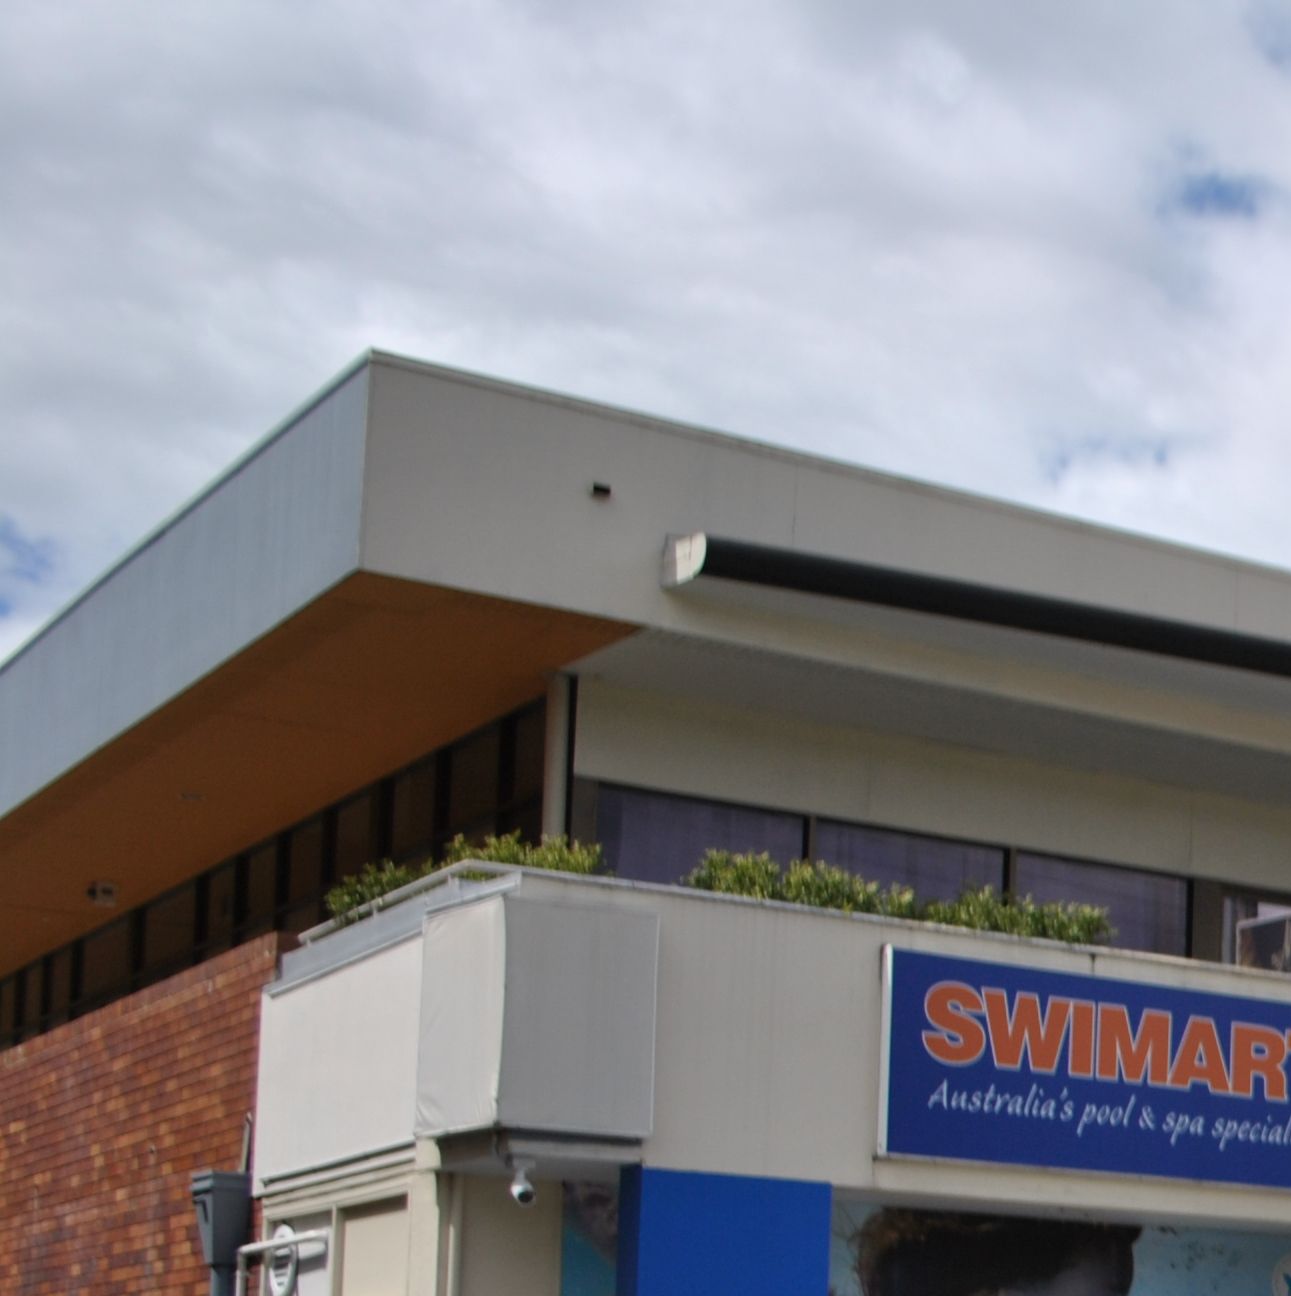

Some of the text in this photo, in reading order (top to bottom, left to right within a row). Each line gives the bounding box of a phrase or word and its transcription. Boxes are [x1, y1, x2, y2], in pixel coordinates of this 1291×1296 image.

[927, 1078, 1074, 1123] Australia's
[1078, 1094, 1136, 1137] pool
[1138, 1105, 1156, 1131] &
[1162, 1112, 1204, 1147] spa
